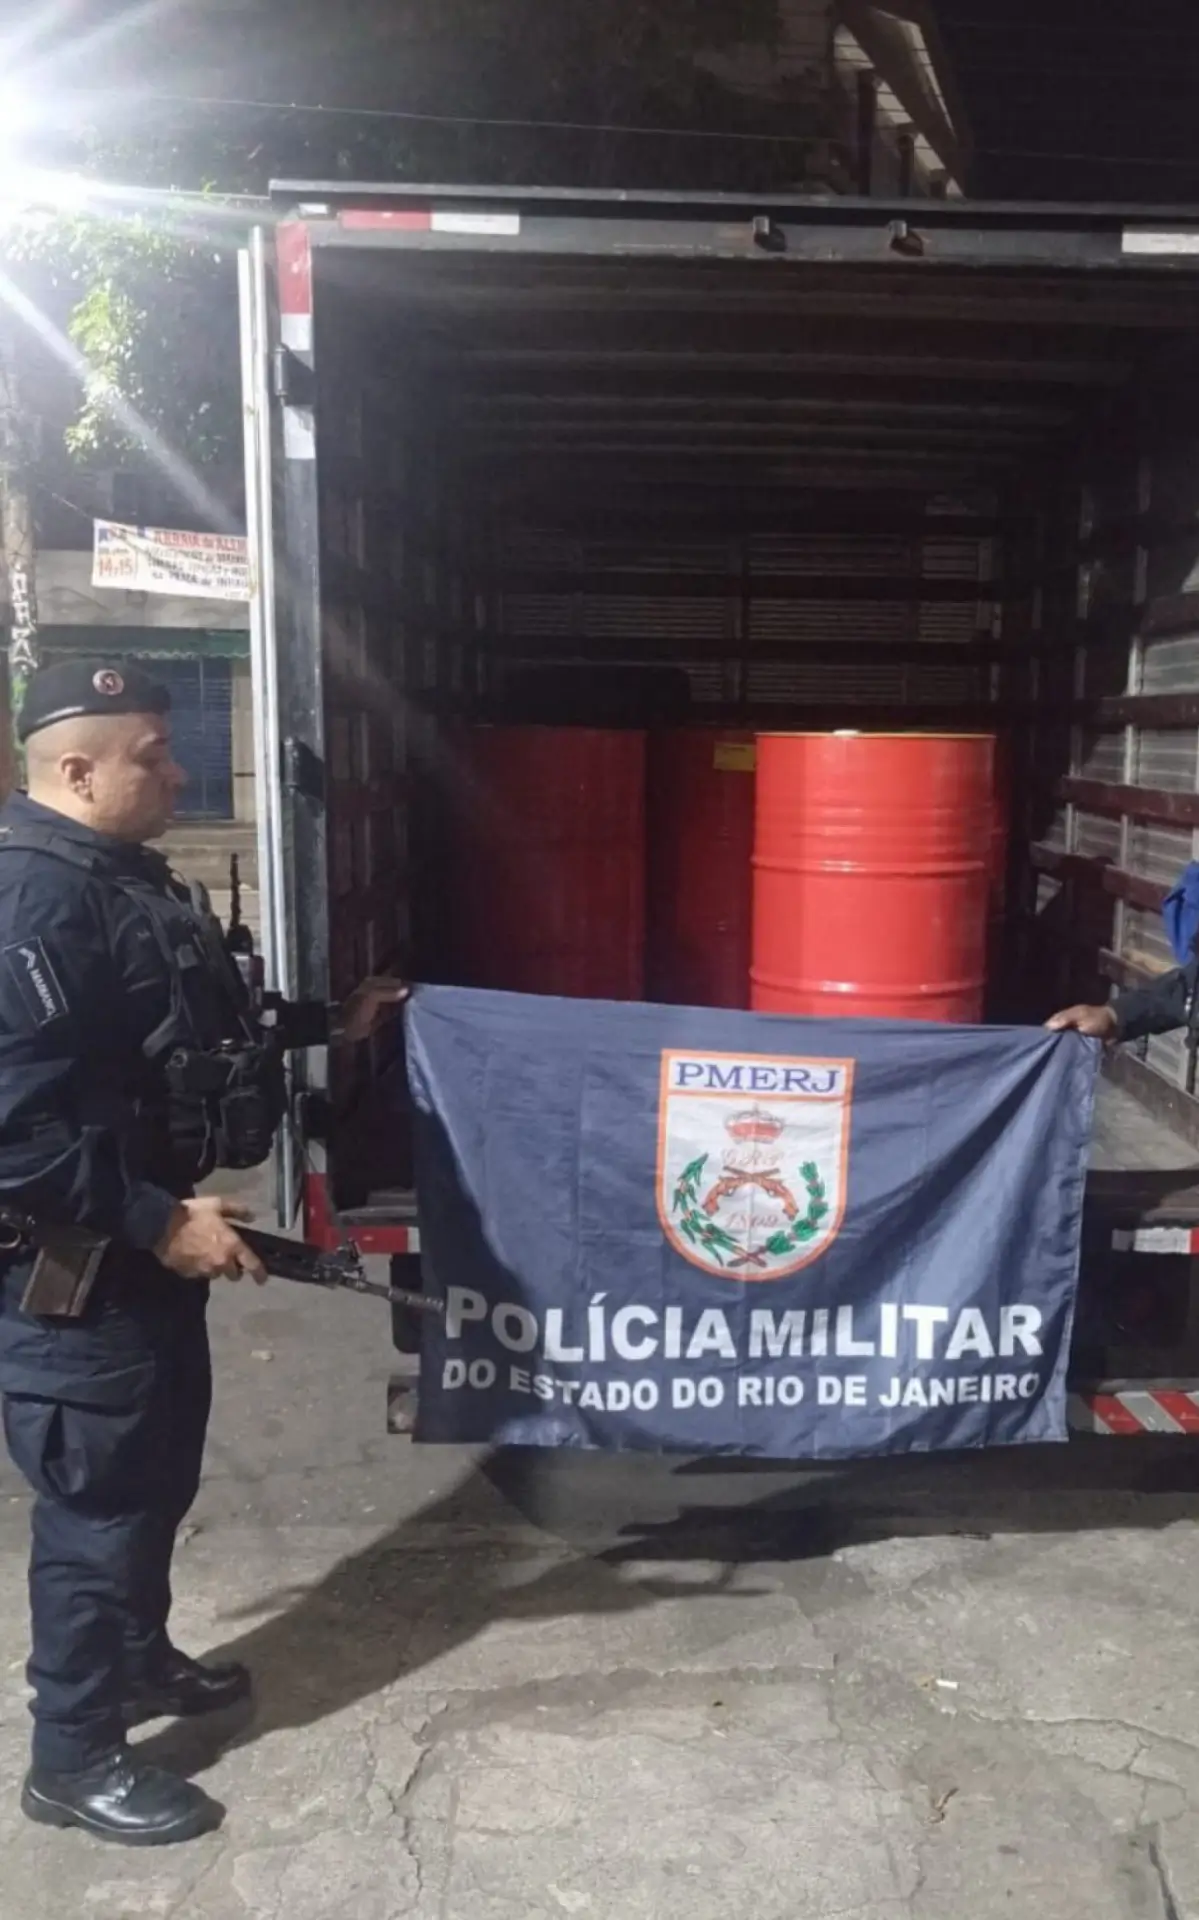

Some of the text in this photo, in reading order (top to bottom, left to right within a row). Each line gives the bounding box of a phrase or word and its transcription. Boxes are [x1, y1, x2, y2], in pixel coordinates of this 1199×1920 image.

[675, 1062, 840, 1093] PMERJ
[446, 1287, 1044, 1362] POLÍCIA MILITAR
[442, 1358, 1040, 1412] DO ESTADO DO RIO DE JANEIRO
